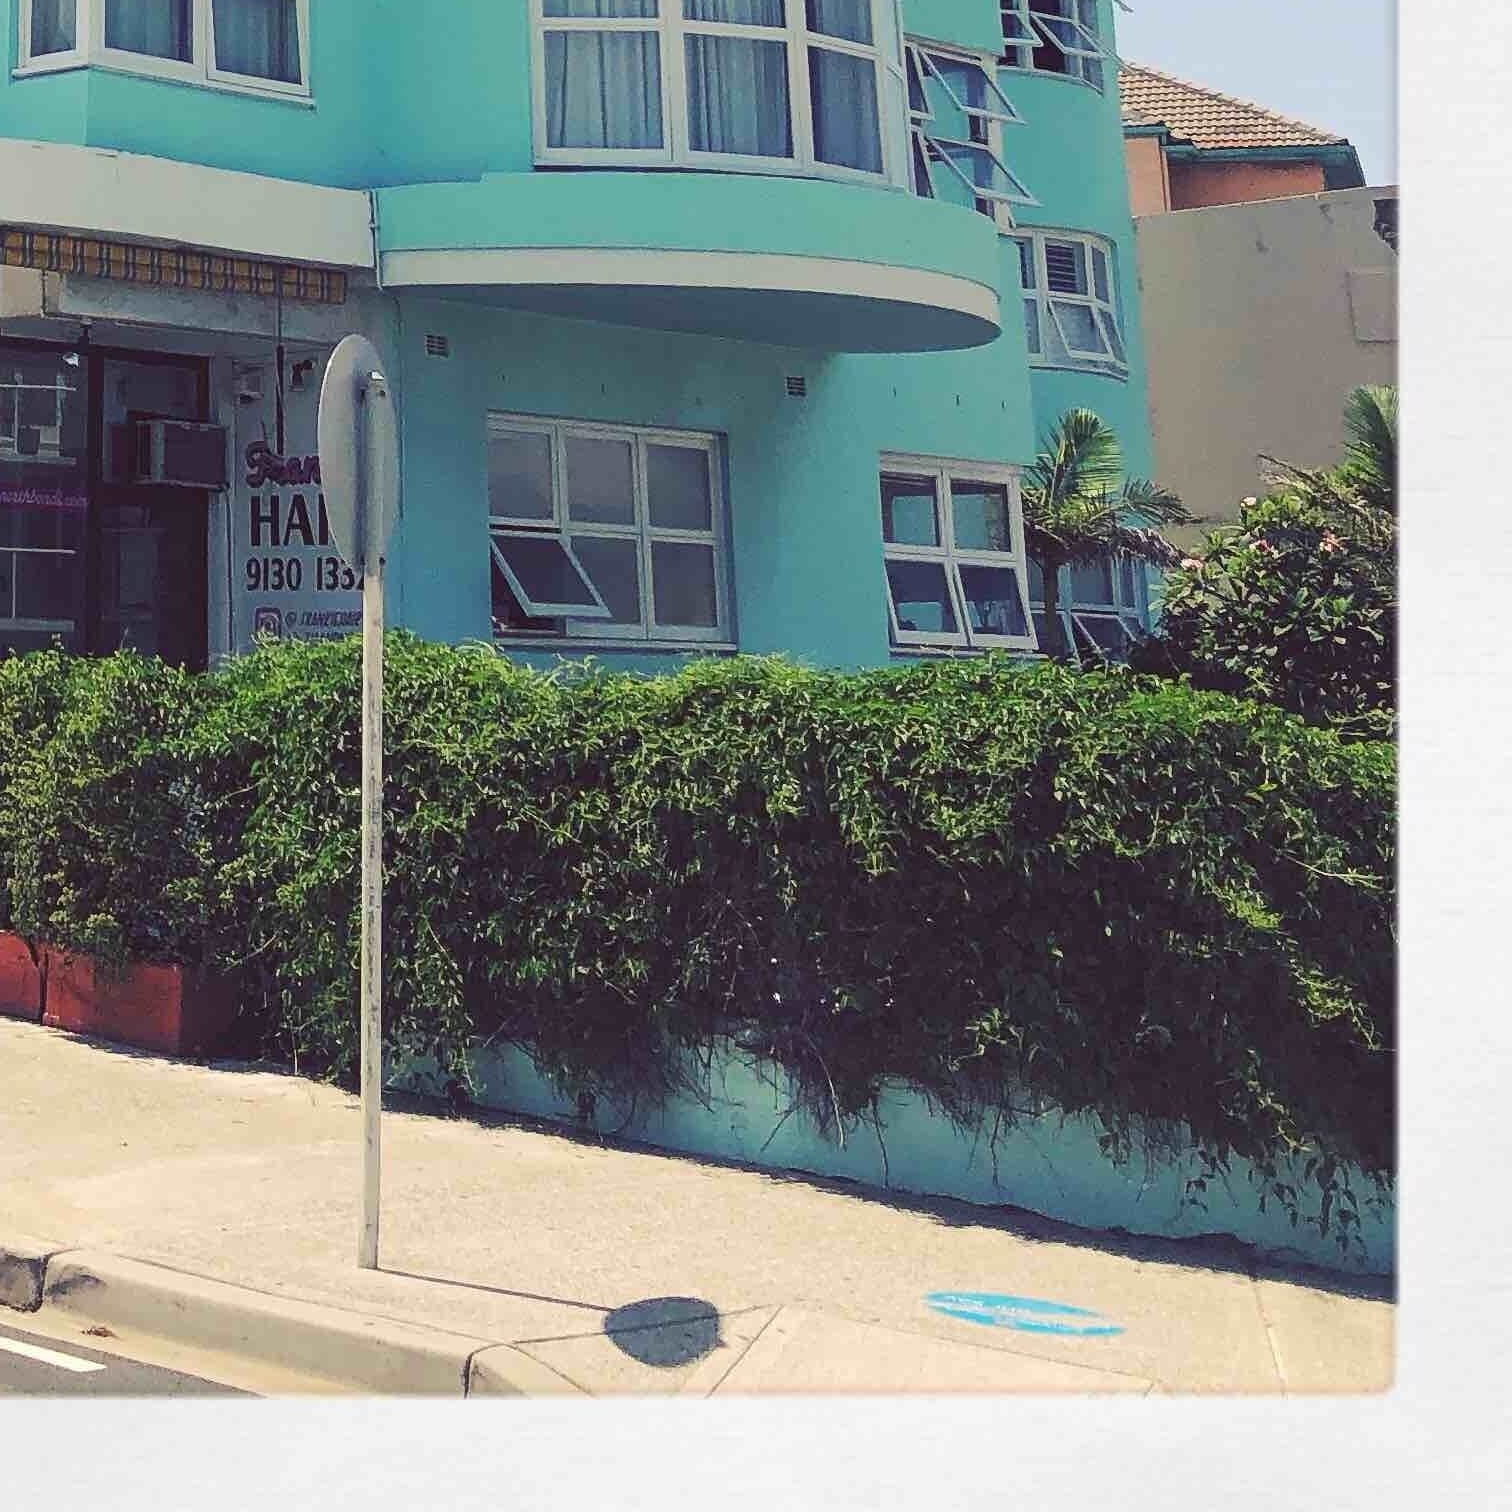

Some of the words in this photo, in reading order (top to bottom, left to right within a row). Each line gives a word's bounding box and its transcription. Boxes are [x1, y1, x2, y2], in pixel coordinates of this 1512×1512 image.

[247, 440, 323, 488] Fran
[250, 493, 329, 547] HAI
[246, 556, 302, 592] 9130
